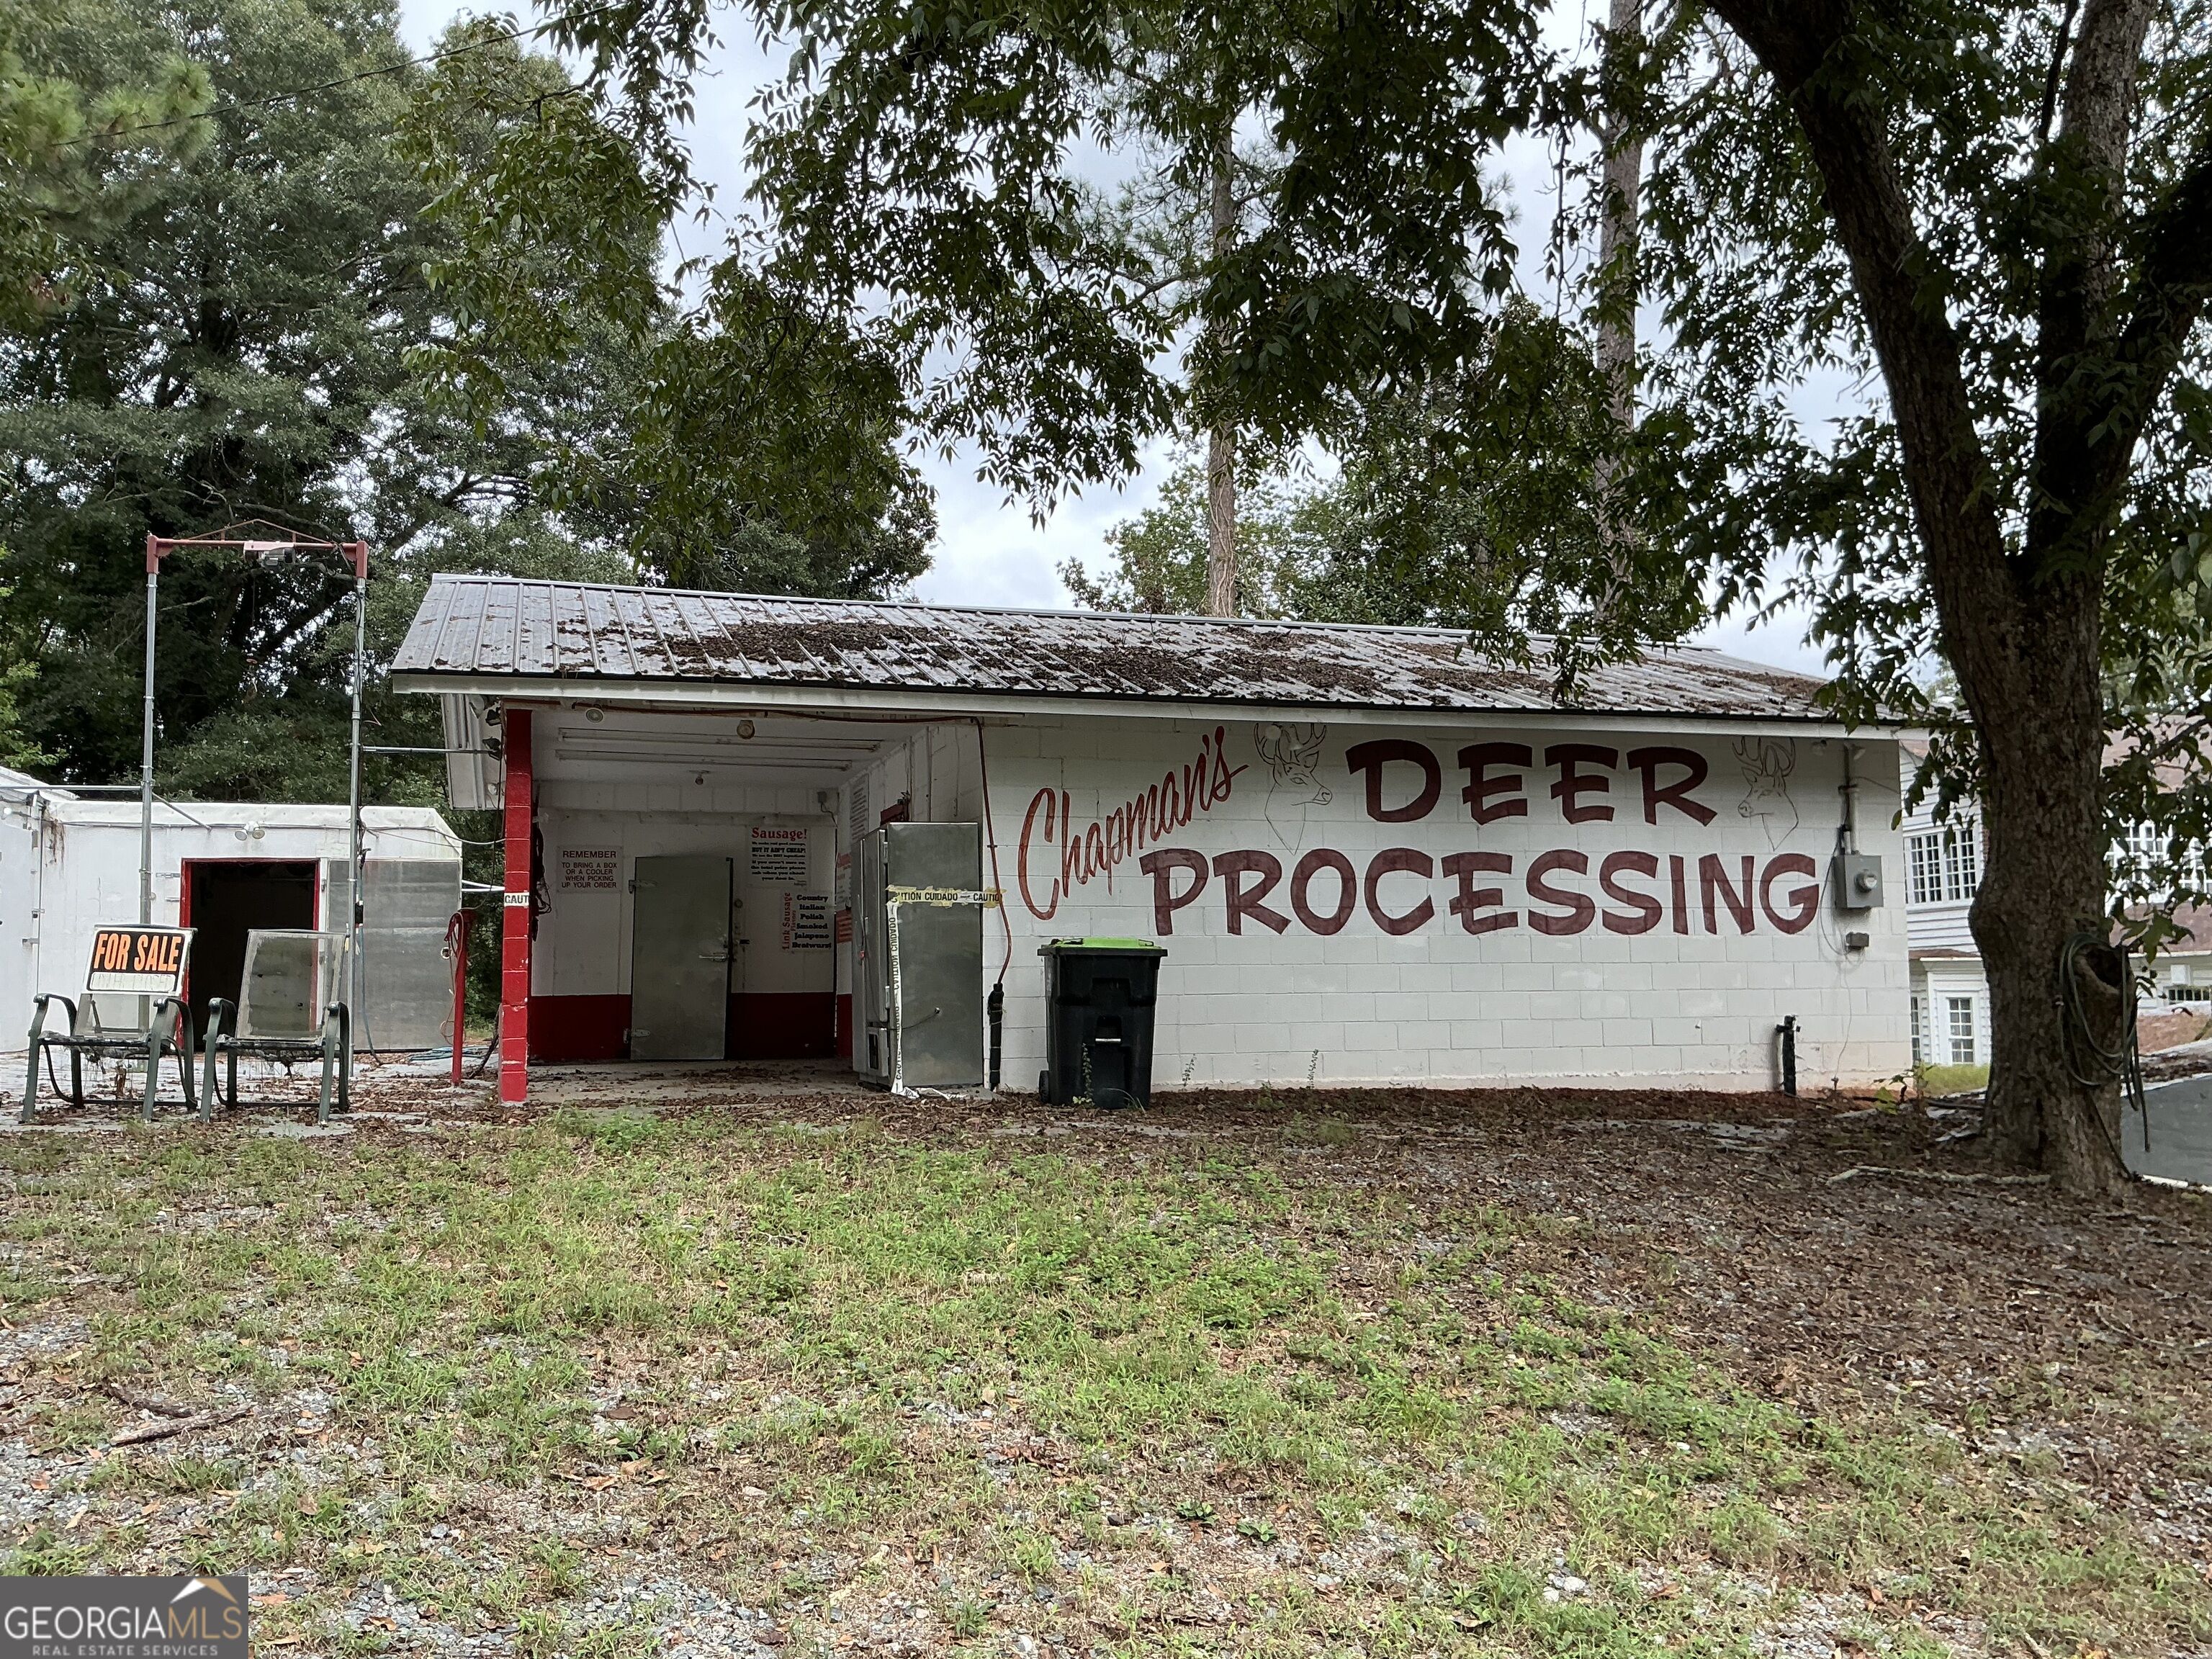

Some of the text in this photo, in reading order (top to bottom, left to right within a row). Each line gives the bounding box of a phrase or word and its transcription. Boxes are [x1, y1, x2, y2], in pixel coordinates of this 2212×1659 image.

[1345, 739, 1717, 827] DEER
[752, 827, 806, 842] Sausage!
[1017, 725, 1249, 920] Chapman's
[796, 894, 829, 903] Country
[925, 892, 958, 902] CUIDADO
[1138, 847, 1820, 936] PROCESSING
[782, 892, 793, 950] Link Sausage
[94, 932, 182, 971] FOR SALE
